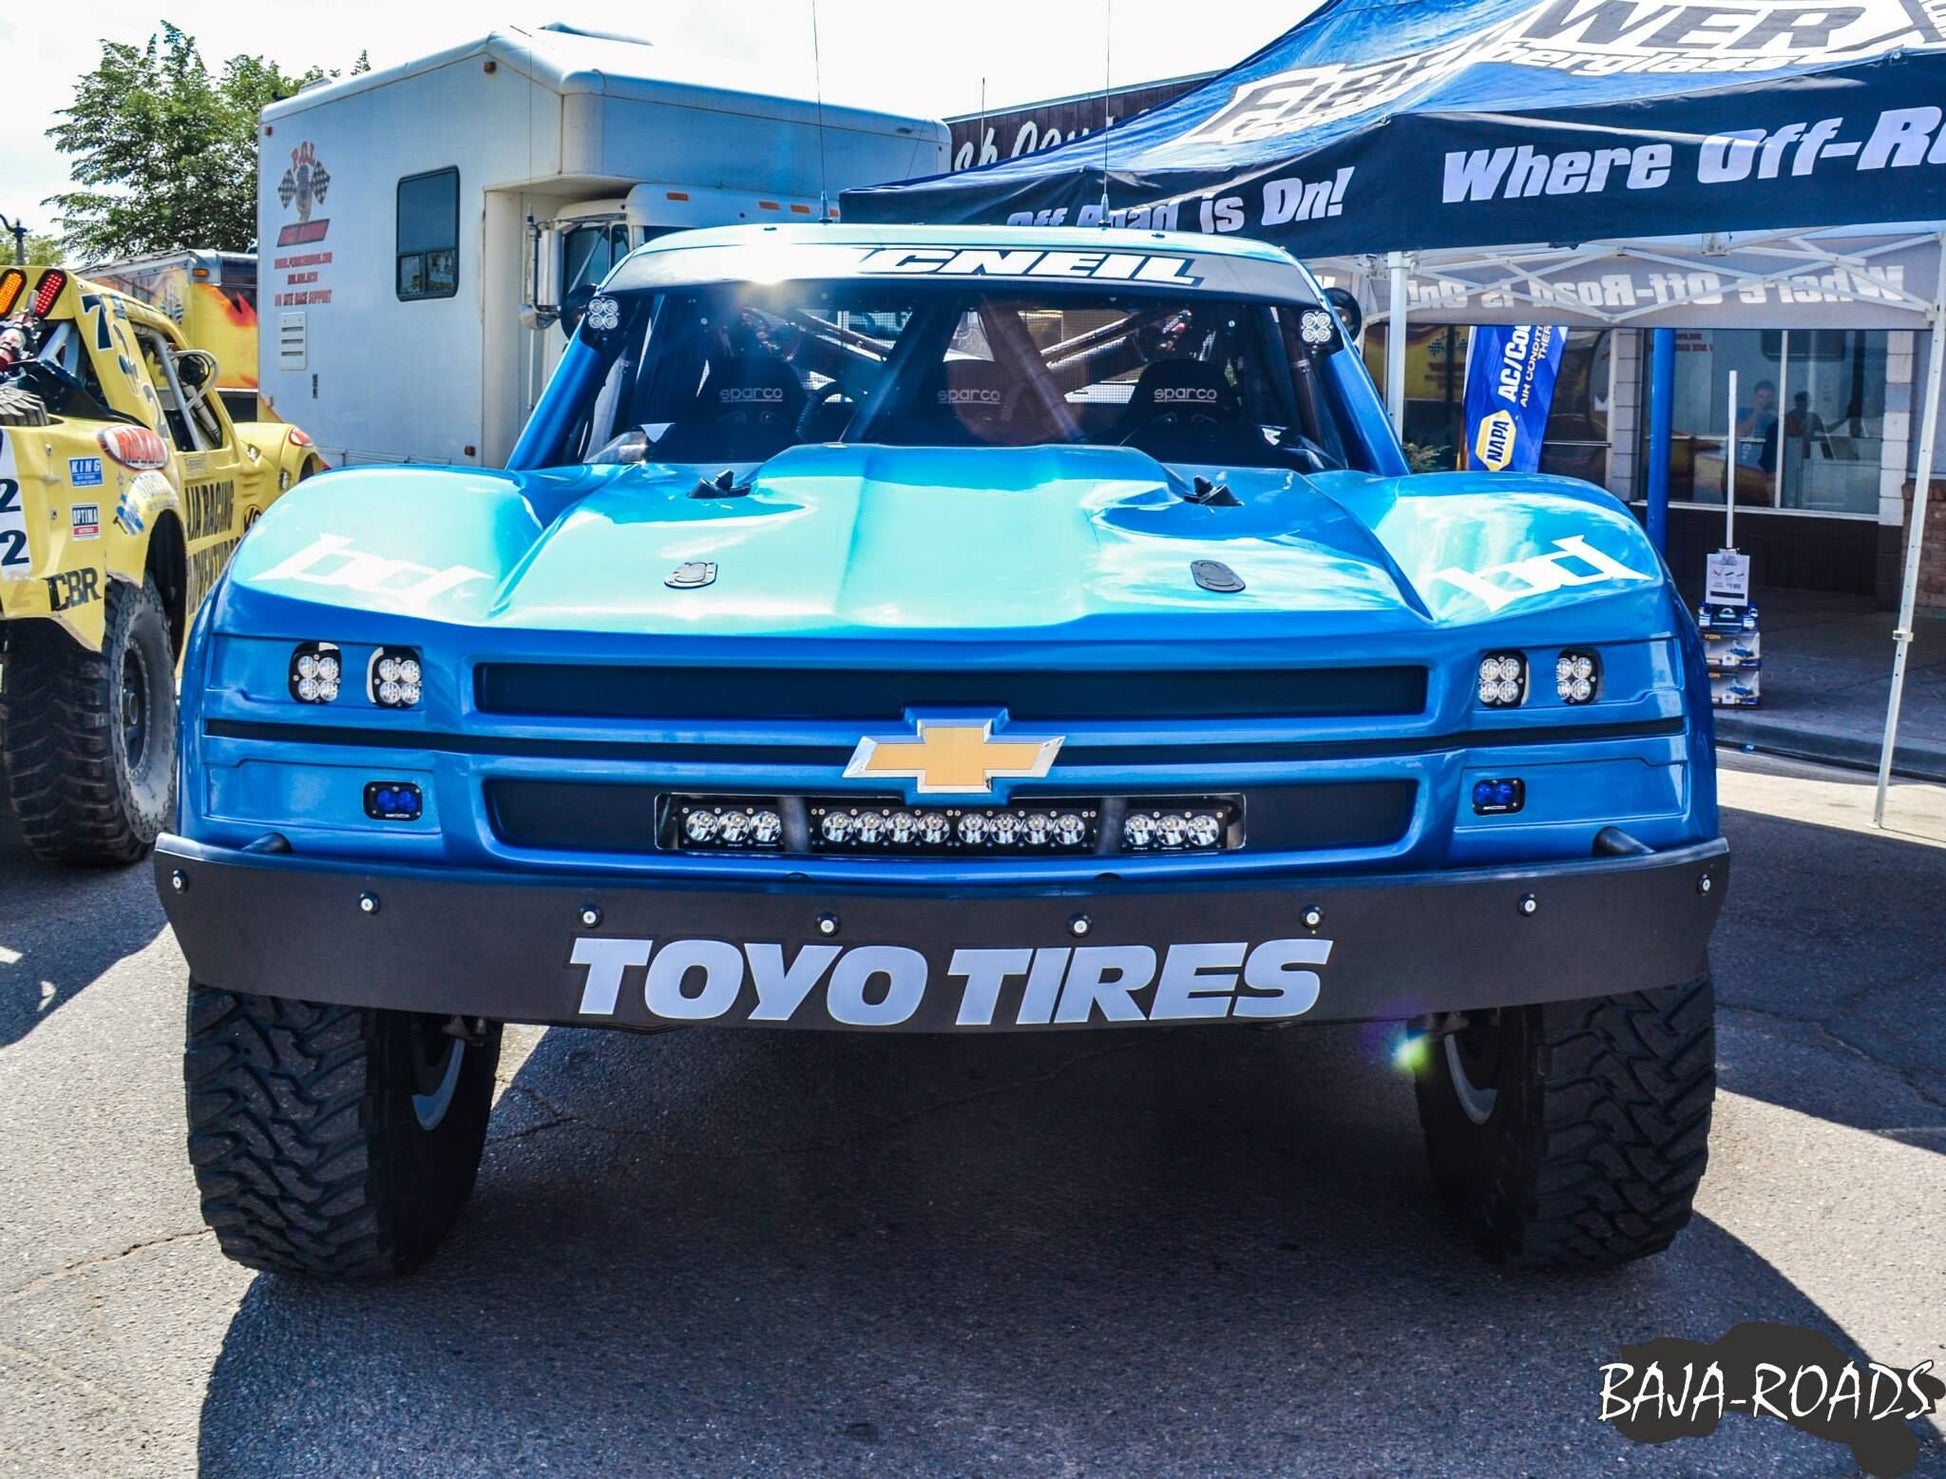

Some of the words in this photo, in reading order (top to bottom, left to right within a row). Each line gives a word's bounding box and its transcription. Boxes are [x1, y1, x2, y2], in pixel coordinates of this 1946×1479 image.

[1442, 143, 1673, 204] Where
[1697, 105, 1946, 184] Off-R
[1200, 193, 1245, 233] is
[1261, 166, 1356, 226] On!
[856, 246, 1205, 288] CNEIL
[80, 294, 114, 350] 7
[719, 386, 783, 403] sparco
[937, 388, 1001, 405] sparco
[1153, 387, 1217, 404] sparco
[1520, 383, 1531, 408] AIR
[1486, 420, 1510, 463] NAPA
[71, 460, 101, 474] KING
[0, 478, 21, 512] 2
[73, 509, 98, 525] OPTIMA
[0, 529, 30, 566] 2
[569, 938, 929, 1024] TOYO
[947, 938, 1334, 1026] TIRES
